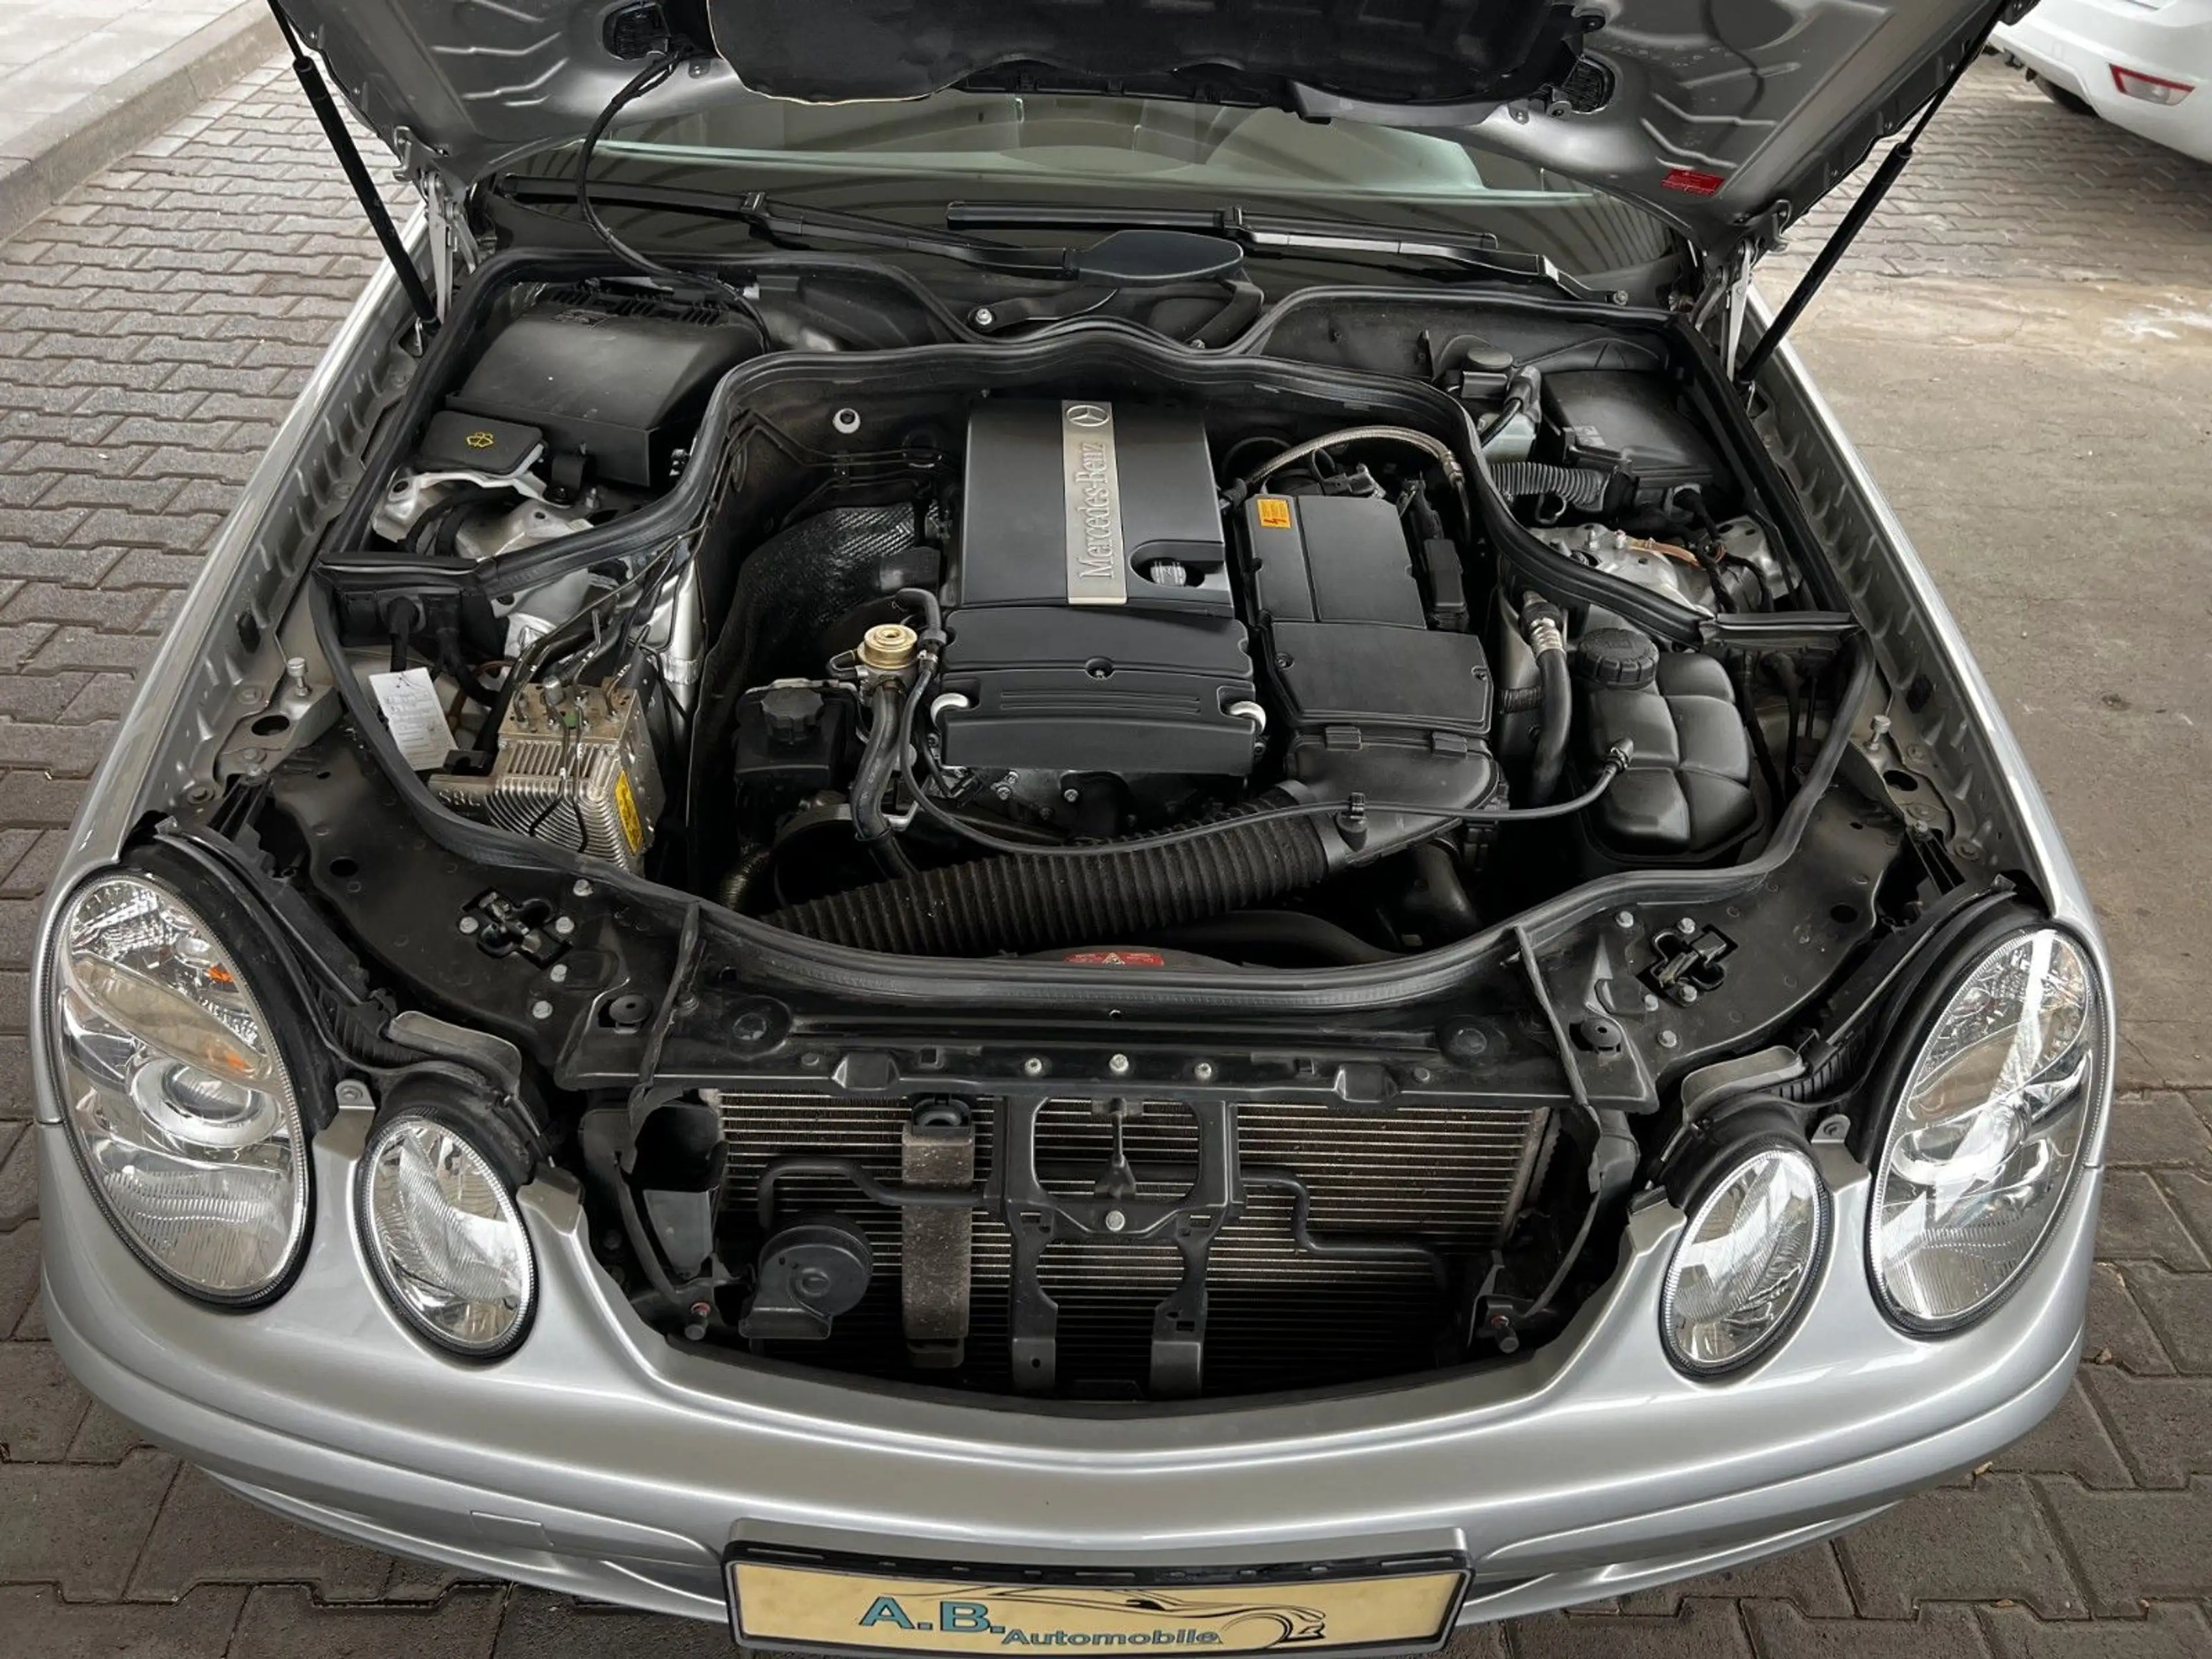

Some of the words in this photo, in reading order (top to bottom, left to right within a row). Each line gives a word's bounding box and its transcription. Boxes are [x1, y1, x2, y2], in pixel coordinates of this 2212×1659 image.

[1075, 441, 1113, 579] Mercedes-Benz
[859, 1596, 1005, 1633] A.B.
[1002, 1628, 1219, 1646] Automobile
